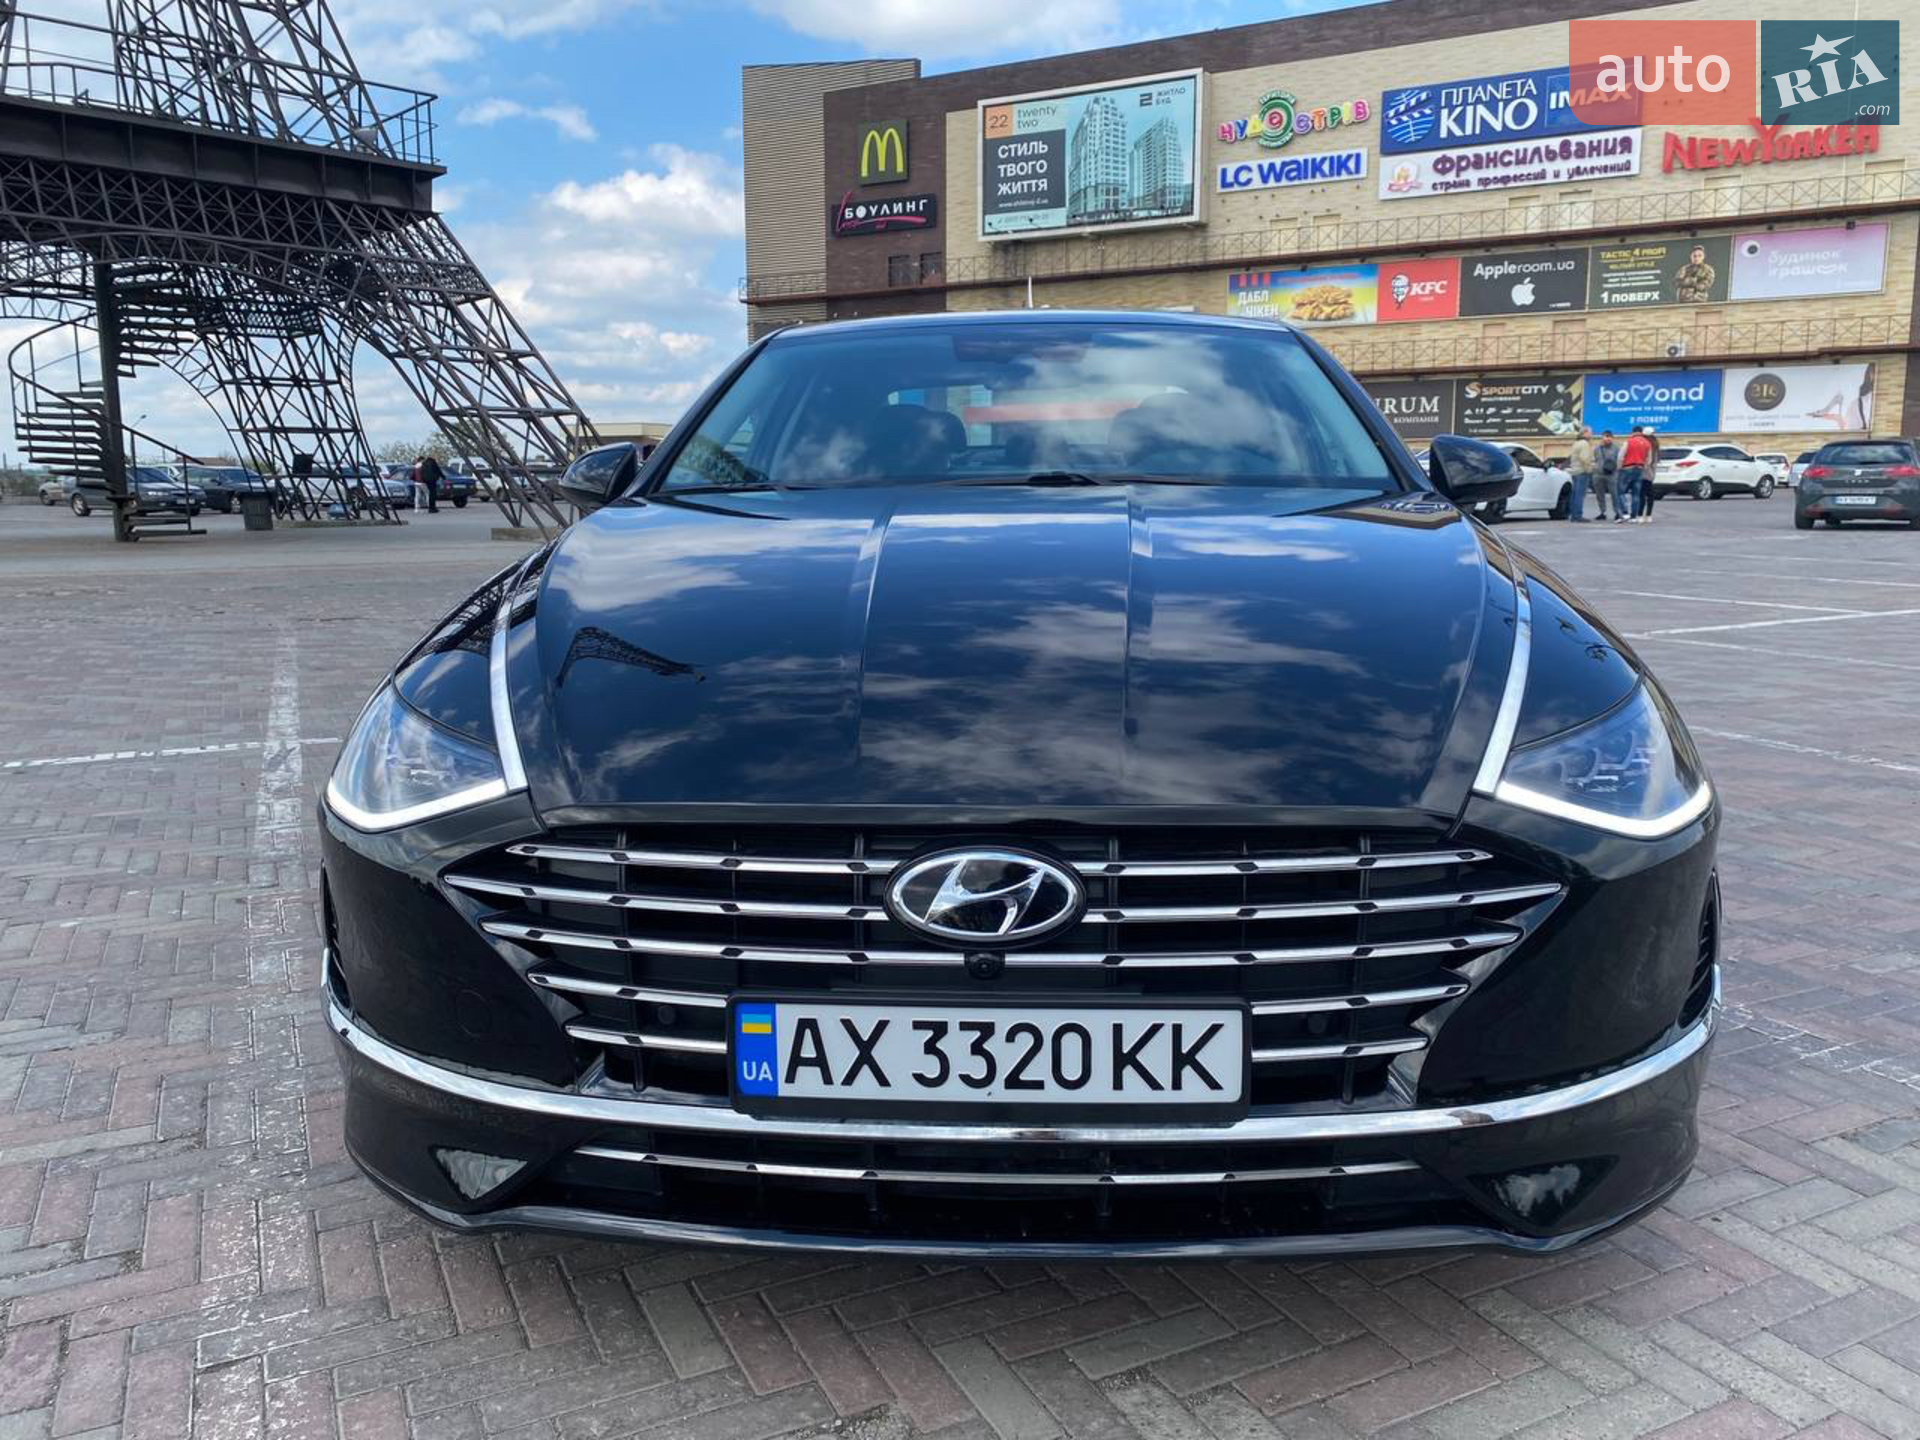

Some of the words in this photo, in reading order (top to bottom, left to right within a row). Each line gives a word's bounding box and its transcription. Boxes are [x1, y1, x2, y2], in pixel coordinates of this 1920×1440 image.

[1017, 104, 1058, 119] twenty
[1439, 98, 1539, 139] KINO
[988, 115, 1008, 128] 22
[1017, 118, 1038, 129] two
[997, 141, 1049, 159] СТИЛЬ
[997, 159, 1048, 179] ТВОГО
[1220, 165, 1253, 189] LC
[997, 179, 1048, 197] ЖИТТЯ
[1431, 179, 1471, 193] страна
[1477, 169, 1546, 189] профессий
[844, 199, 928, 219] БОУЛИНГ
[1474, 260, 1576, 279] Appleroom.ua
[1238, 290, 1269, 306] ДАБЛ
[1409, 281, 1448, 296] KFC
[1601, 291, 1609, 304] 1
[1611, 291, 1660, 303] ПОВЕРХ
[1375, 395, 1440, 415] RUM
[785, 1018, 891, 1087] AX
[911, 1020, 1092, 1090] 3320
[1112, 1022, 1224, 1091] KK
[743, 1061, 773, 1081] UA
